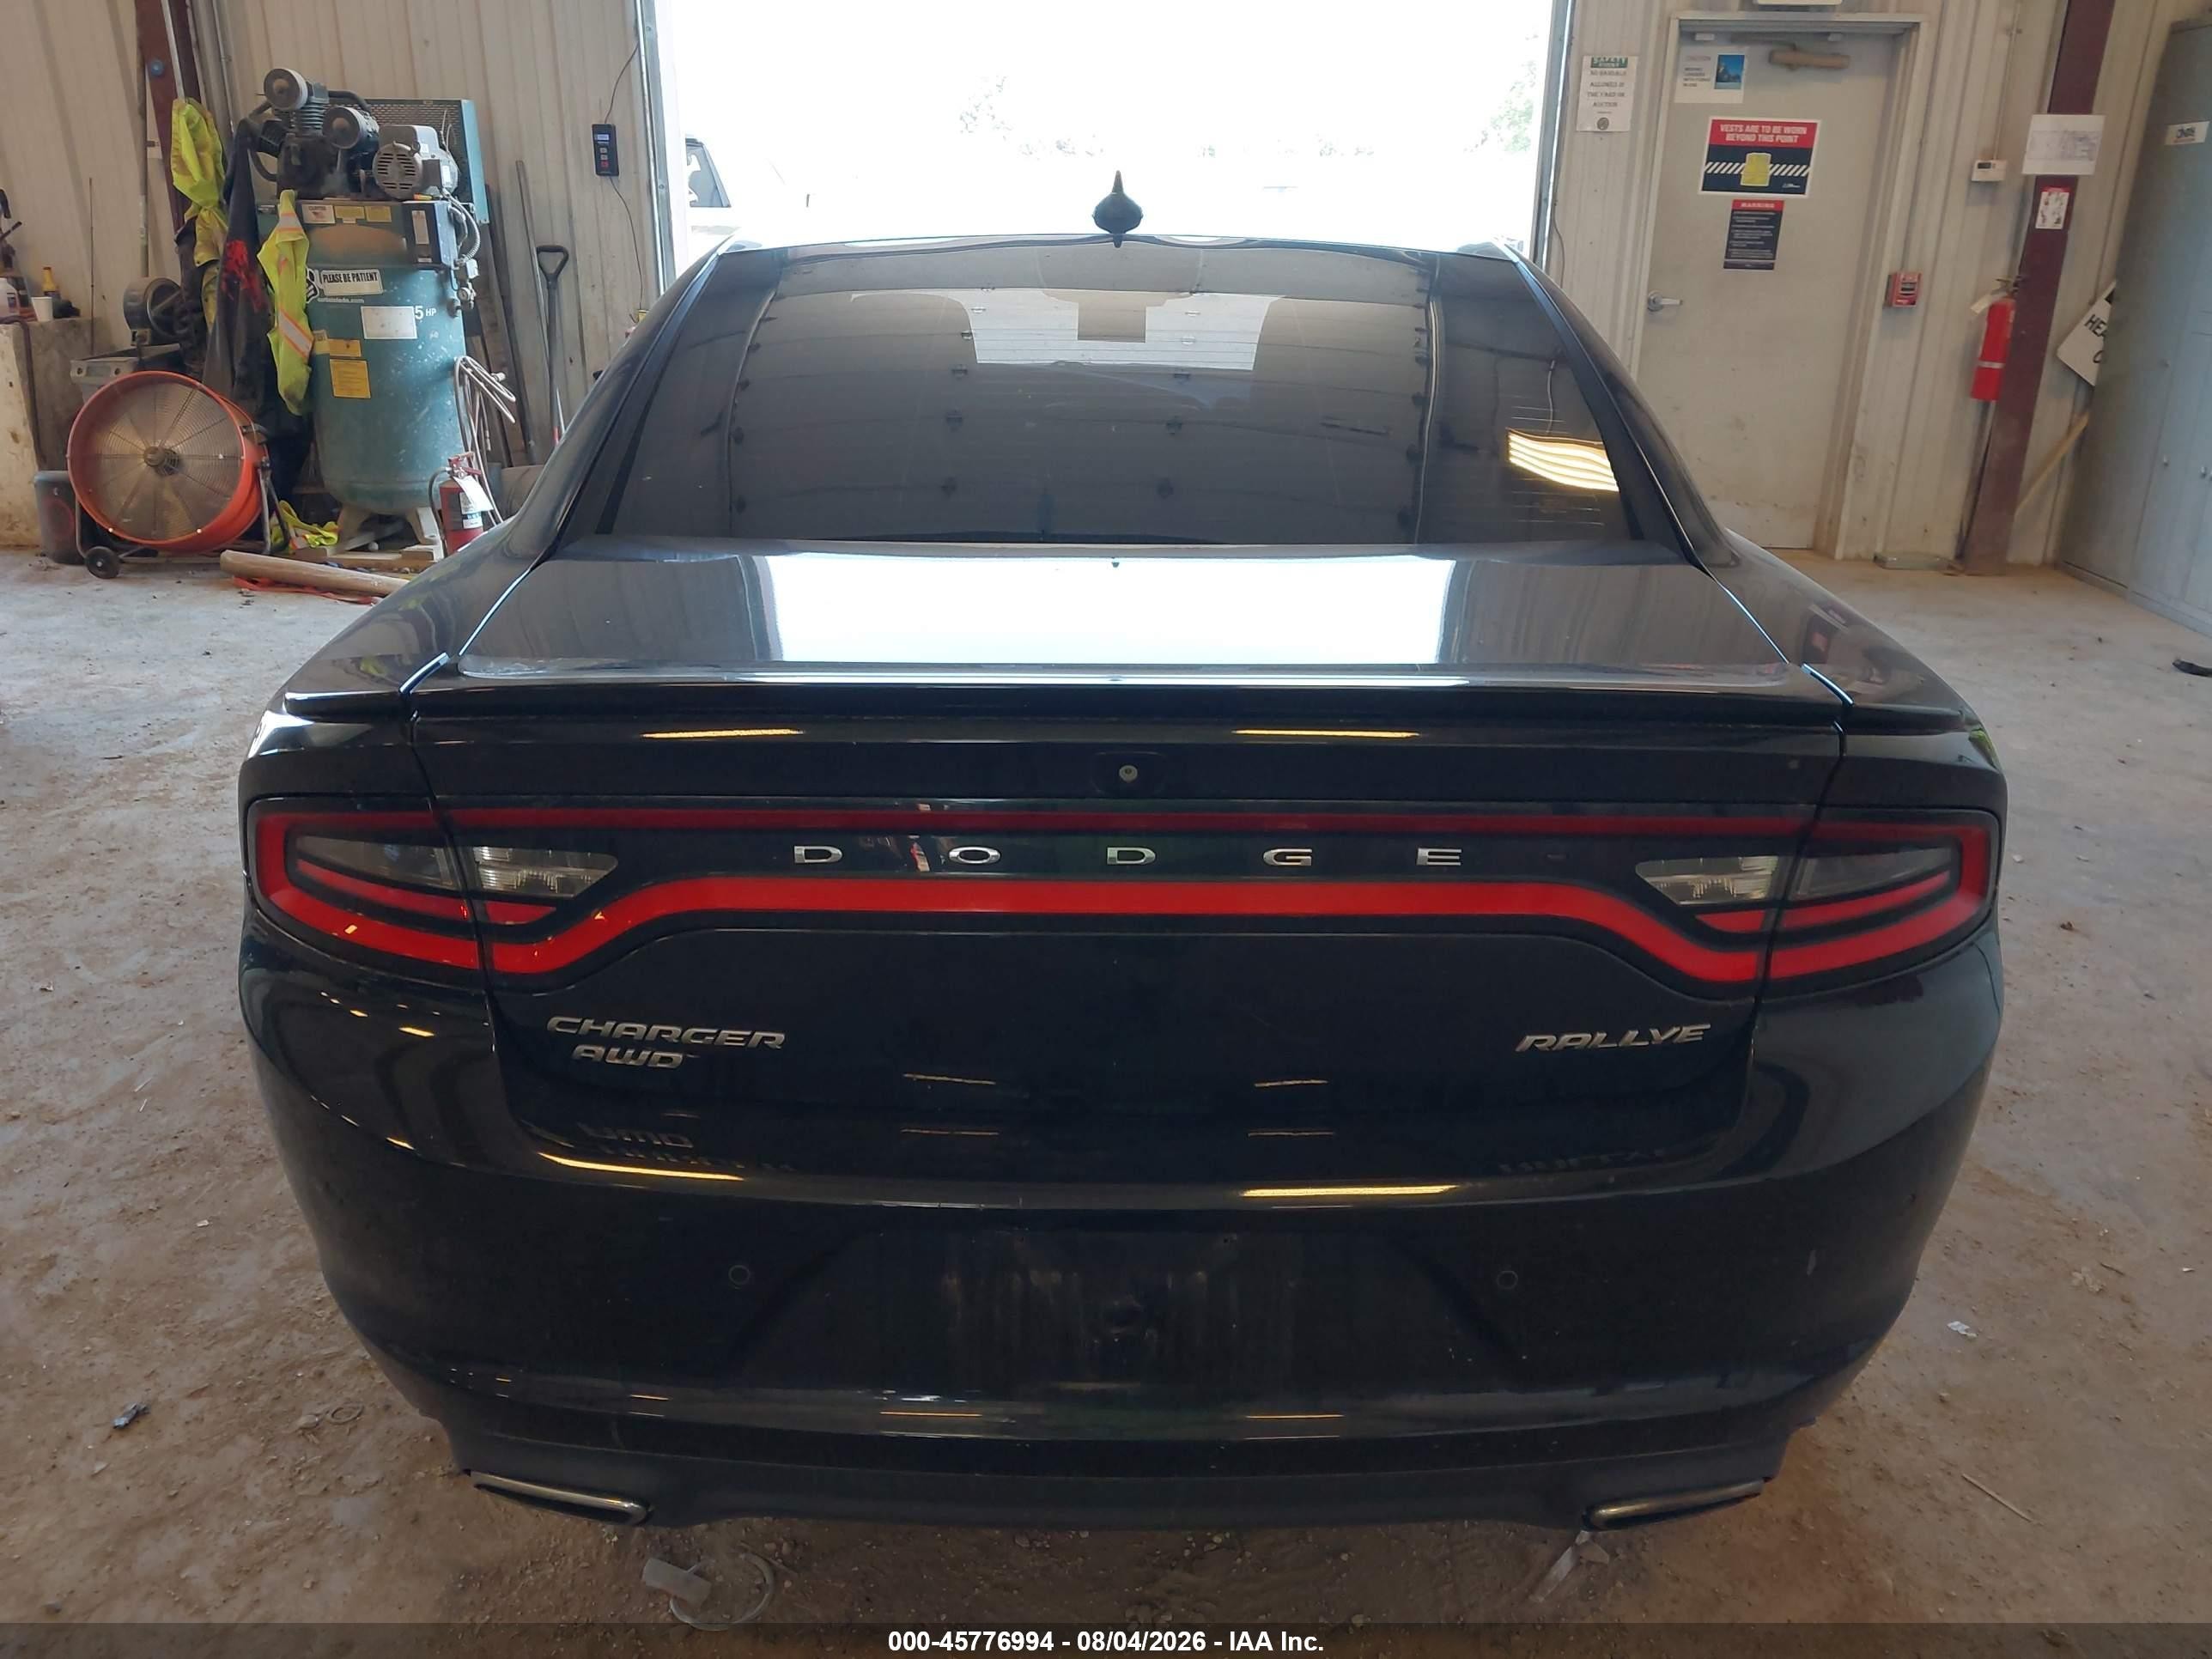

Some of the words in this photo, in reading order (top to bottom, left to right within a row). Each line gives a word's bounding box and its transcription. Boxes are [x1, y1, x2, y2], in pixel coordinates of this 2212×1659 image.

[1720, 124, 1744, 132] VESTS
[1745, 125, 1759, 133] ARE
[323, 273, 343, 283] PLEASE
[343, 273, 351, 283] BE
[351, 271, 378, 282] PATIENT
[415, 305, 424, 319] 5
[426, 308, 437, 317] HP
[793, 845, 1462, 866] DODGE
[546, 1016, 786, 1049] CHARGER
[571, 1044, 684, 1069] AWD
